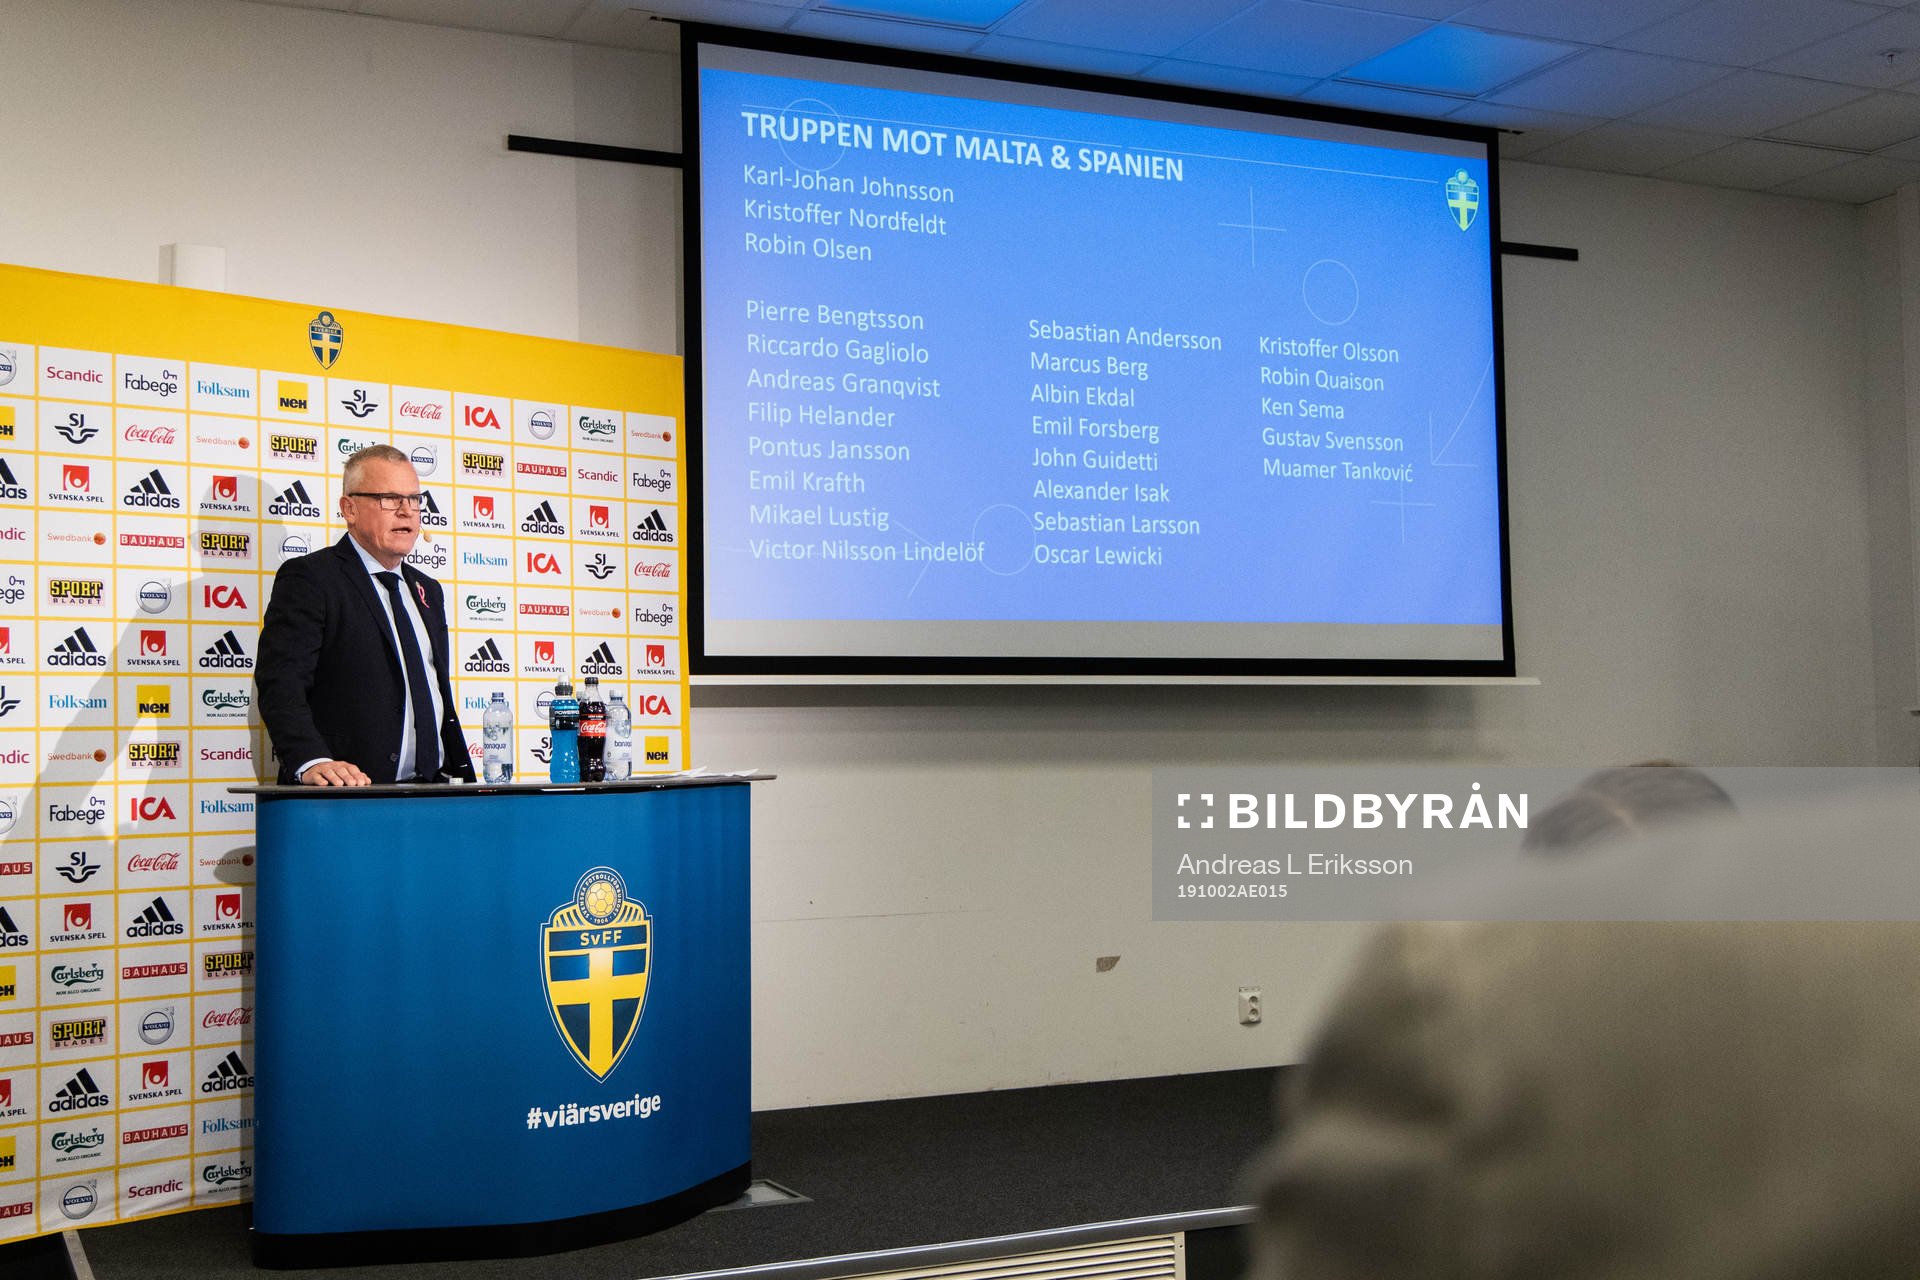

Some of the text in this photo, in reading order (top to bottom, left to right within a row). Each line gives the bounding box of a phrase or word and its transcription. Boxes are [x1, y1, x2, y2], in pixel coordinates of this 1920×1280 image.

[741, 112, 1184, 181] TRUPPEN MOT MALTA & SPANIEN
[743, 165, 954, 203] Karl-Johan Johnsson
[744, 199, 947, 235] Kristoffer Nordfeldt
[745, 233, 872, 261] Robin Olsen
[746, 300, 924, 331] Pierre Bengtsson
[1029, 320, 1222, 351] Sebastian Andersson
[747, 335, 929, 365] Riccardo Gagliolo
[1260, 336, 1399, 362] Kristoffer Olsson
[47, 366, 103, 384] Scandic
[1031, 353, 1148, 380] Marcus Berg
[125, 373, 178, 397] Fabege
[747, 369, 941, 399] Andreas Granqvist
[1261, 367, 1384, 391] Robin Quaison
[197, 381, 250, 399] Folksam
[354, 390, 366, 403] SJ
[1031, 384, 1135, 407] Albin Ekdal
[465, 406, 500, 429] ICA
[748, 402, 895, 427] Filip Helander
[1262, 398, 1345, 419] Ken Sema
[69, 413, 84, 427] SJ
[579, 416, 616, 434] Carlsberg
[1033, 416, 1159, 443] Emil Forsberg
[196, 436, 237, 446] Swedbank
[270, 435, 317, 454] SPORT
[1262, 427, 1403, 451] Gustav Svensson
[274, 452, 315, 460] BLADET
[749, 437, 910, 461] Pontus Jansson
[463, 452, 503, 470] SPORT
[1033, 448, 1159, 471] John Guidetti
[518, 463, 566, 476] BAUHAUS
[578, 468, 618, 482] Scandic
[1263, 458, 1414, 482] Muamer Tanković
[633, 472, 671, 492] Fabege
[750, 470, 865, 492] Emil Krafth
[49, 494, 84, 502] SVENSKA
[1033, 480, 1170, 502] Alexander Isak
[124, 492, 180, 509] adidas
[268, 503, 320, 518] adidas
[750, 504, 889, 531] Mikael Lustig
[522, 521, 564, 535] adidas
[1034, 512, 1200, 534] Sebastian Larsson
[48, 533, 92, 542] Swedbank
[122, 534, 183, 548] BAUHAUS
[201, 532, 248, 550] SPORT
[632, 530, 673, 542] adidas
[464, 552, 508, 566] Folksam
[750, 539, 985, 562] Victor Nilsson Lindelöf
[1035, 545, 1162, 565] Oscar Lewicki
[402, 551, 446, 569] abege
[528, 552, 561, 574] ICA
[596, 554, 606, 566] SJ
[50, 580, 102, 598] SPORT
[140, 592, 167, 600] VOLVO
[204, 585, 247, 609] ICA
[466, 595, 506, 614] Carlsberg
[520, 605, 568, 616] BAUHAUS
[578, 608, 610, 616] Swedbank
[635, 608, 672, 626] Fabege
[48, 652, 106, 666] adidas
[199, 655, 252, 668] adidas
[464, 660, 510, 673] adidas
[580, 662, 622, 675] adidas
[49, 695, 107, 708] Folksam
[202, 690, 250, 710] Carlsberg
[640, 696, 672, 715] ICA
[129, 743, 178, 761] SPORT
[541, 737, 552, 749] SJ
[48, 752, 92, 762] Swedbank
[201, 749, 252, 761] Scandic
[50, 805, 105, 824] Fabege
[131, 797, 176, 820] ICA
[200, 800, 254, 814] Folksam
[71, 852, 86, 866] SJ
[50, 934, 86, 942] SVENSKA
[127, 922, 183, 938] adidas
[580, 930, 622, 946] SvFF
[51, 966, 104, 986] Carlsberg
[124, 964, 187, 978] BAUHAUS
[52, 1019, 106, 1040] SPORT
[143, 1022, 169, 1030] VOLVO
[55, 1038, 104, 1048] BLADET
[202, 1076, 254, 1092] adidas
[49, 1094, 108, 1112] adidas
[129, 1091, 162, 1100] SVENSKA
[527, 1094, 661, 1130] #viärsverige
[52, 1131, 104, 1152] Carlsberg
[124, 1126, 188, 1143] BAUHAUS
[128, 1180, 183, 1198] Scandic
[64, 1196, 92, 1205] VOLVO
